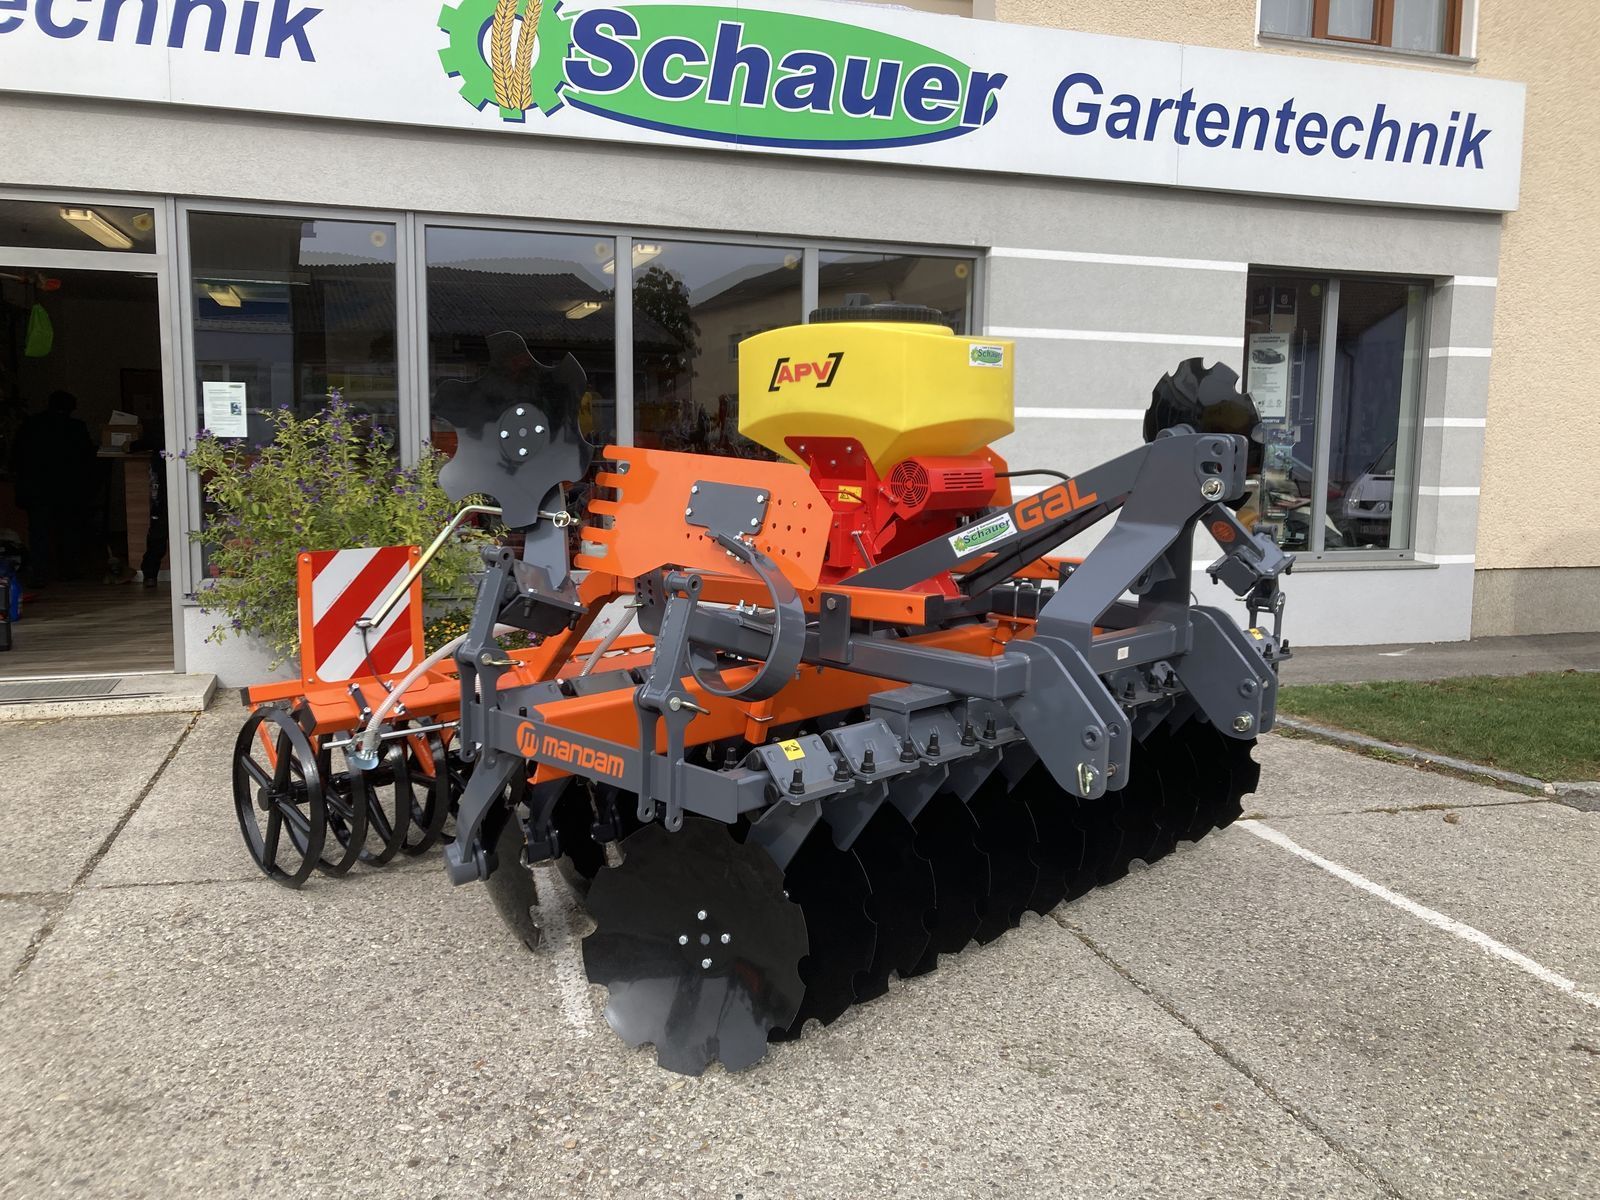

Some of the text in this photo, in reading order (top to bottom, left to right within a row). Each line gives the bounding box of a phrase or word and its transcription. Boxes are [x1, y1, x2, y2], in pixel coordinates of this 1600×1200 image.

[0, 0, 324, 62] chnik
[564, 8, 1008, 126] Schauer
[1051, 71, 1493, 170] Gartentechnik
[963, 519, 1010, 544] Schauer
